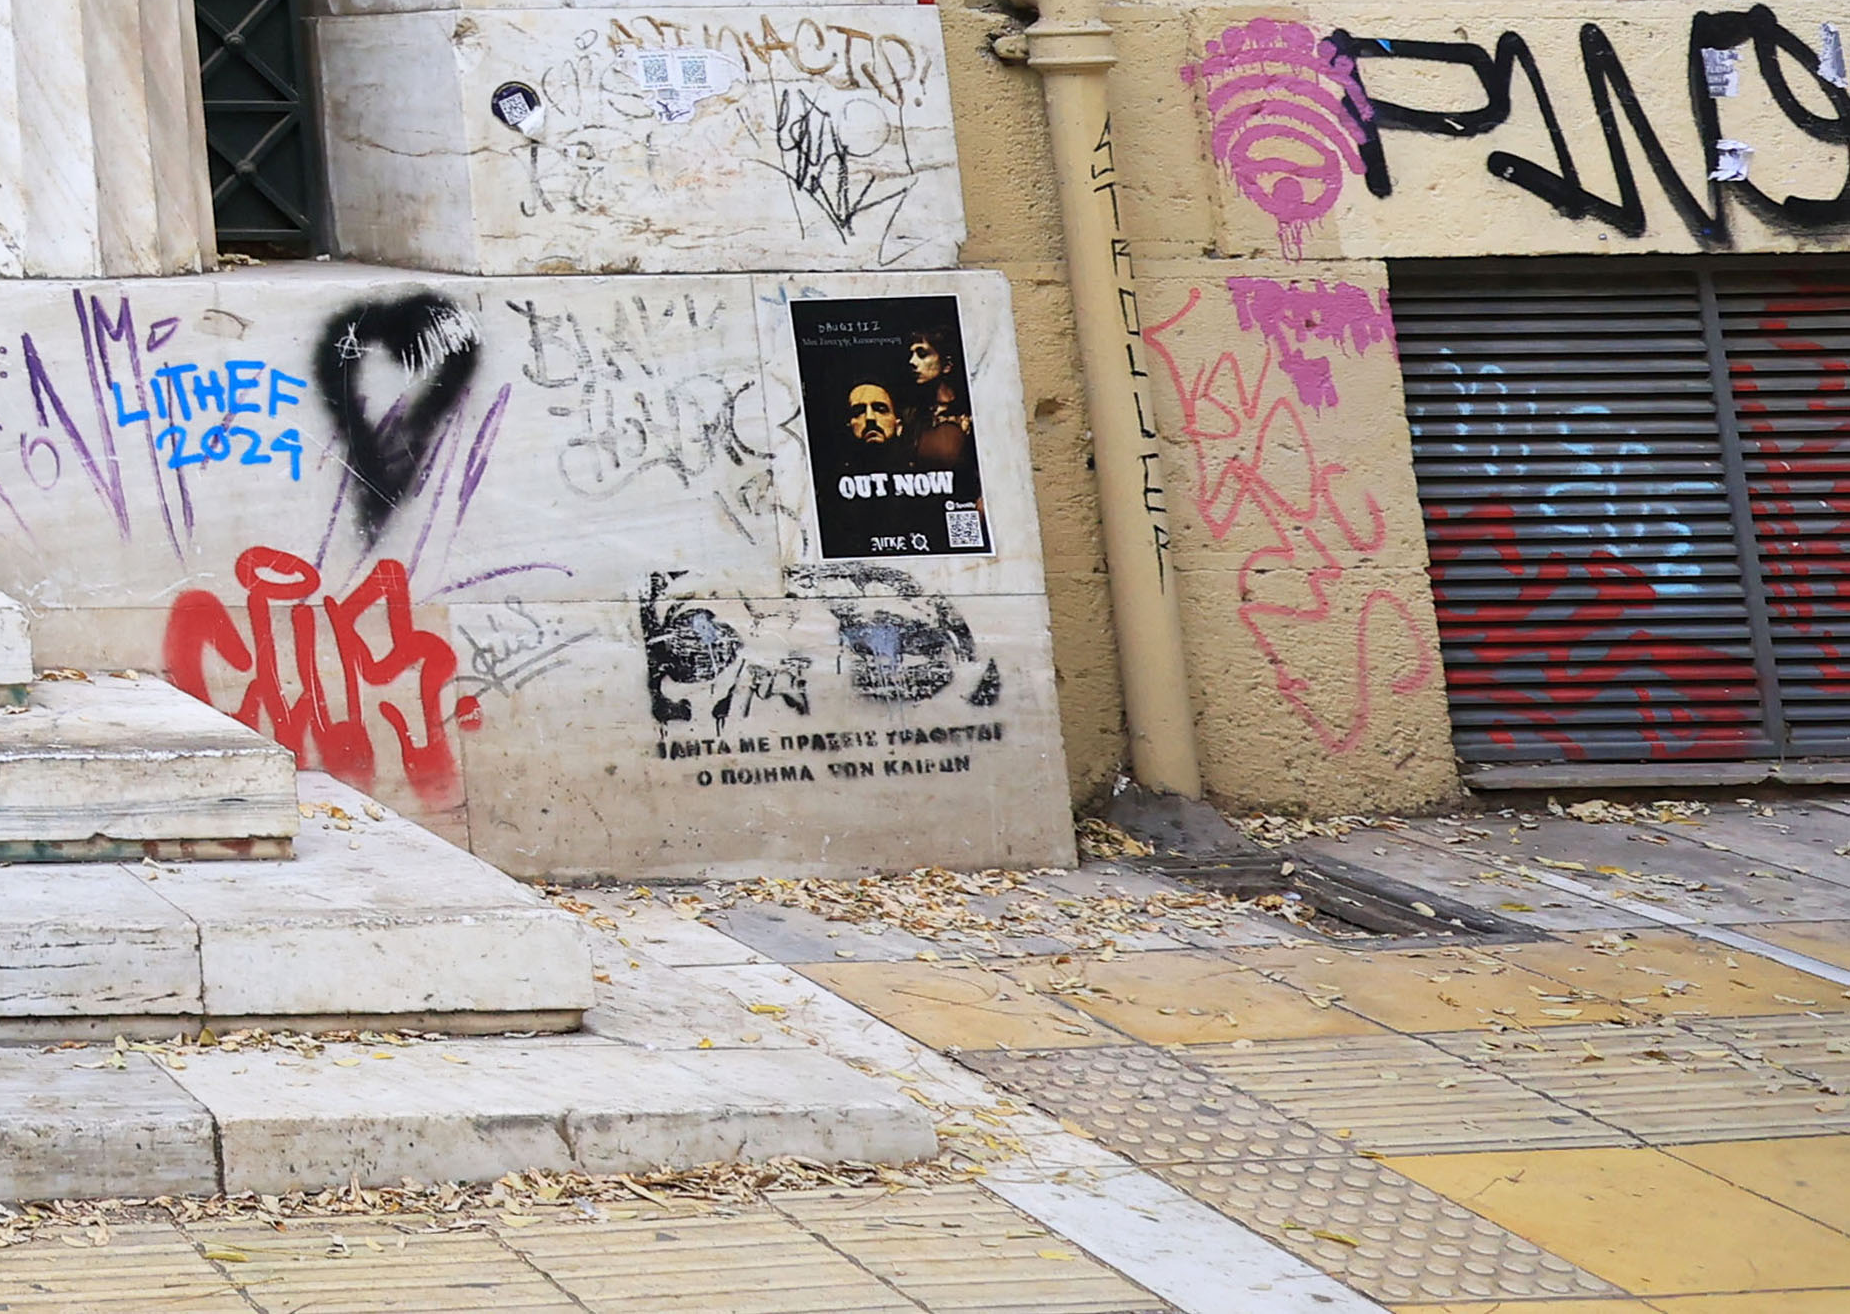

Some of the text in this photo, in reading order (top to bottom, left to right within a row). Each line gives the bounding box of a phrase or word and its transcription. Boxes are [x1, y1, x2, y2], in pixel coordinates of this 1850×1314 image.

[113, 361, 307, 427] LITHEF
[838, 471, 954, 499] OUT NOW
[739, 736, 770, 754] ΜΕ
